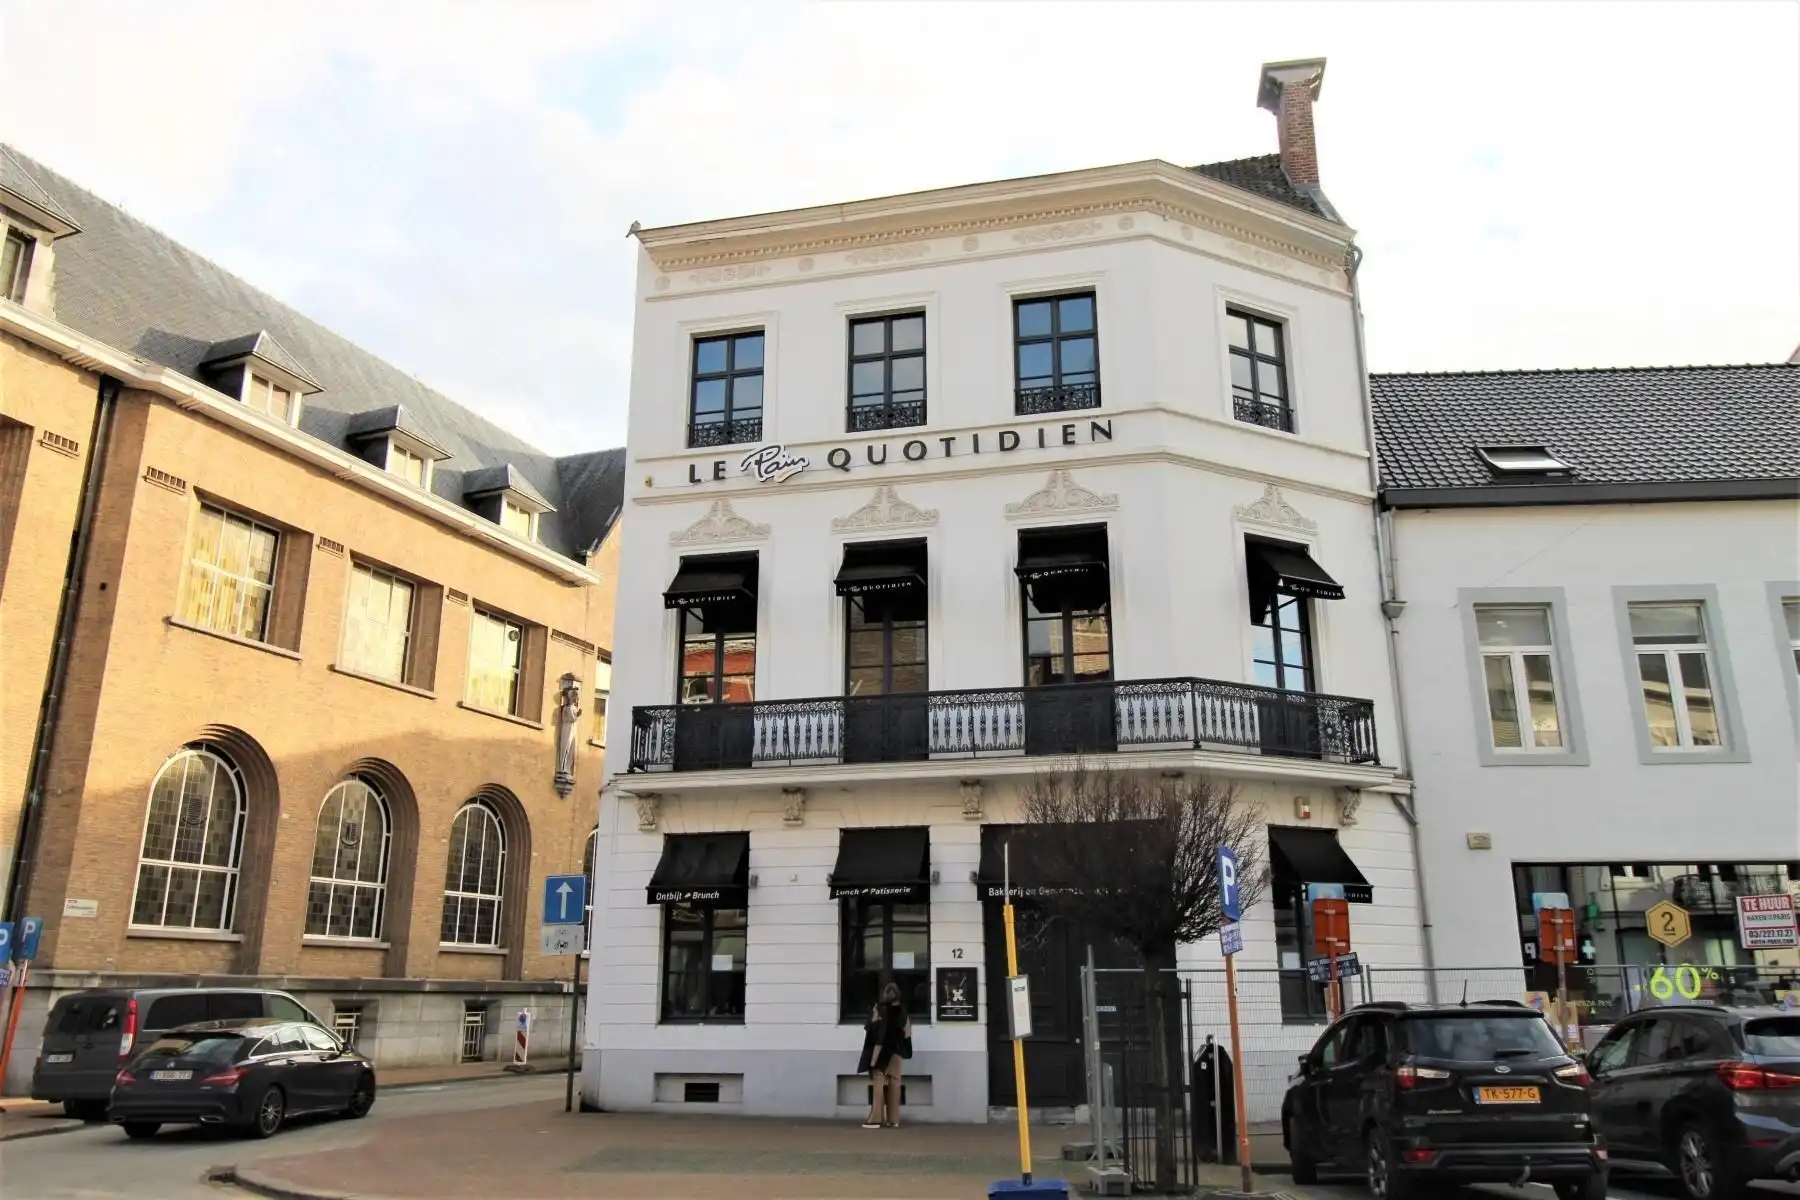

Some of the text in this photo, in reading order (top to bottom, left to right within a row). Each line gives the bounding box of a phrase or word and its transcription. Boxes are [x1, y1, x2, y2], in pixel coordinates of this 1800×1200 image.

[689, 419, 1113, 484] LE Pain QUOTIDIEN
[1222, 855, 1236, 906] P
[656, 891, 720, 901] Ontbijt Brunch
[835, 886, 911, 896] Lunch Patisserie
[1742, 896, 1790, 911] TE HUUR
[24, 920, 37, 942] P
[951, 948, 964, 959] 12
[1483, 1087, 1537, 1100] TK-577-G
